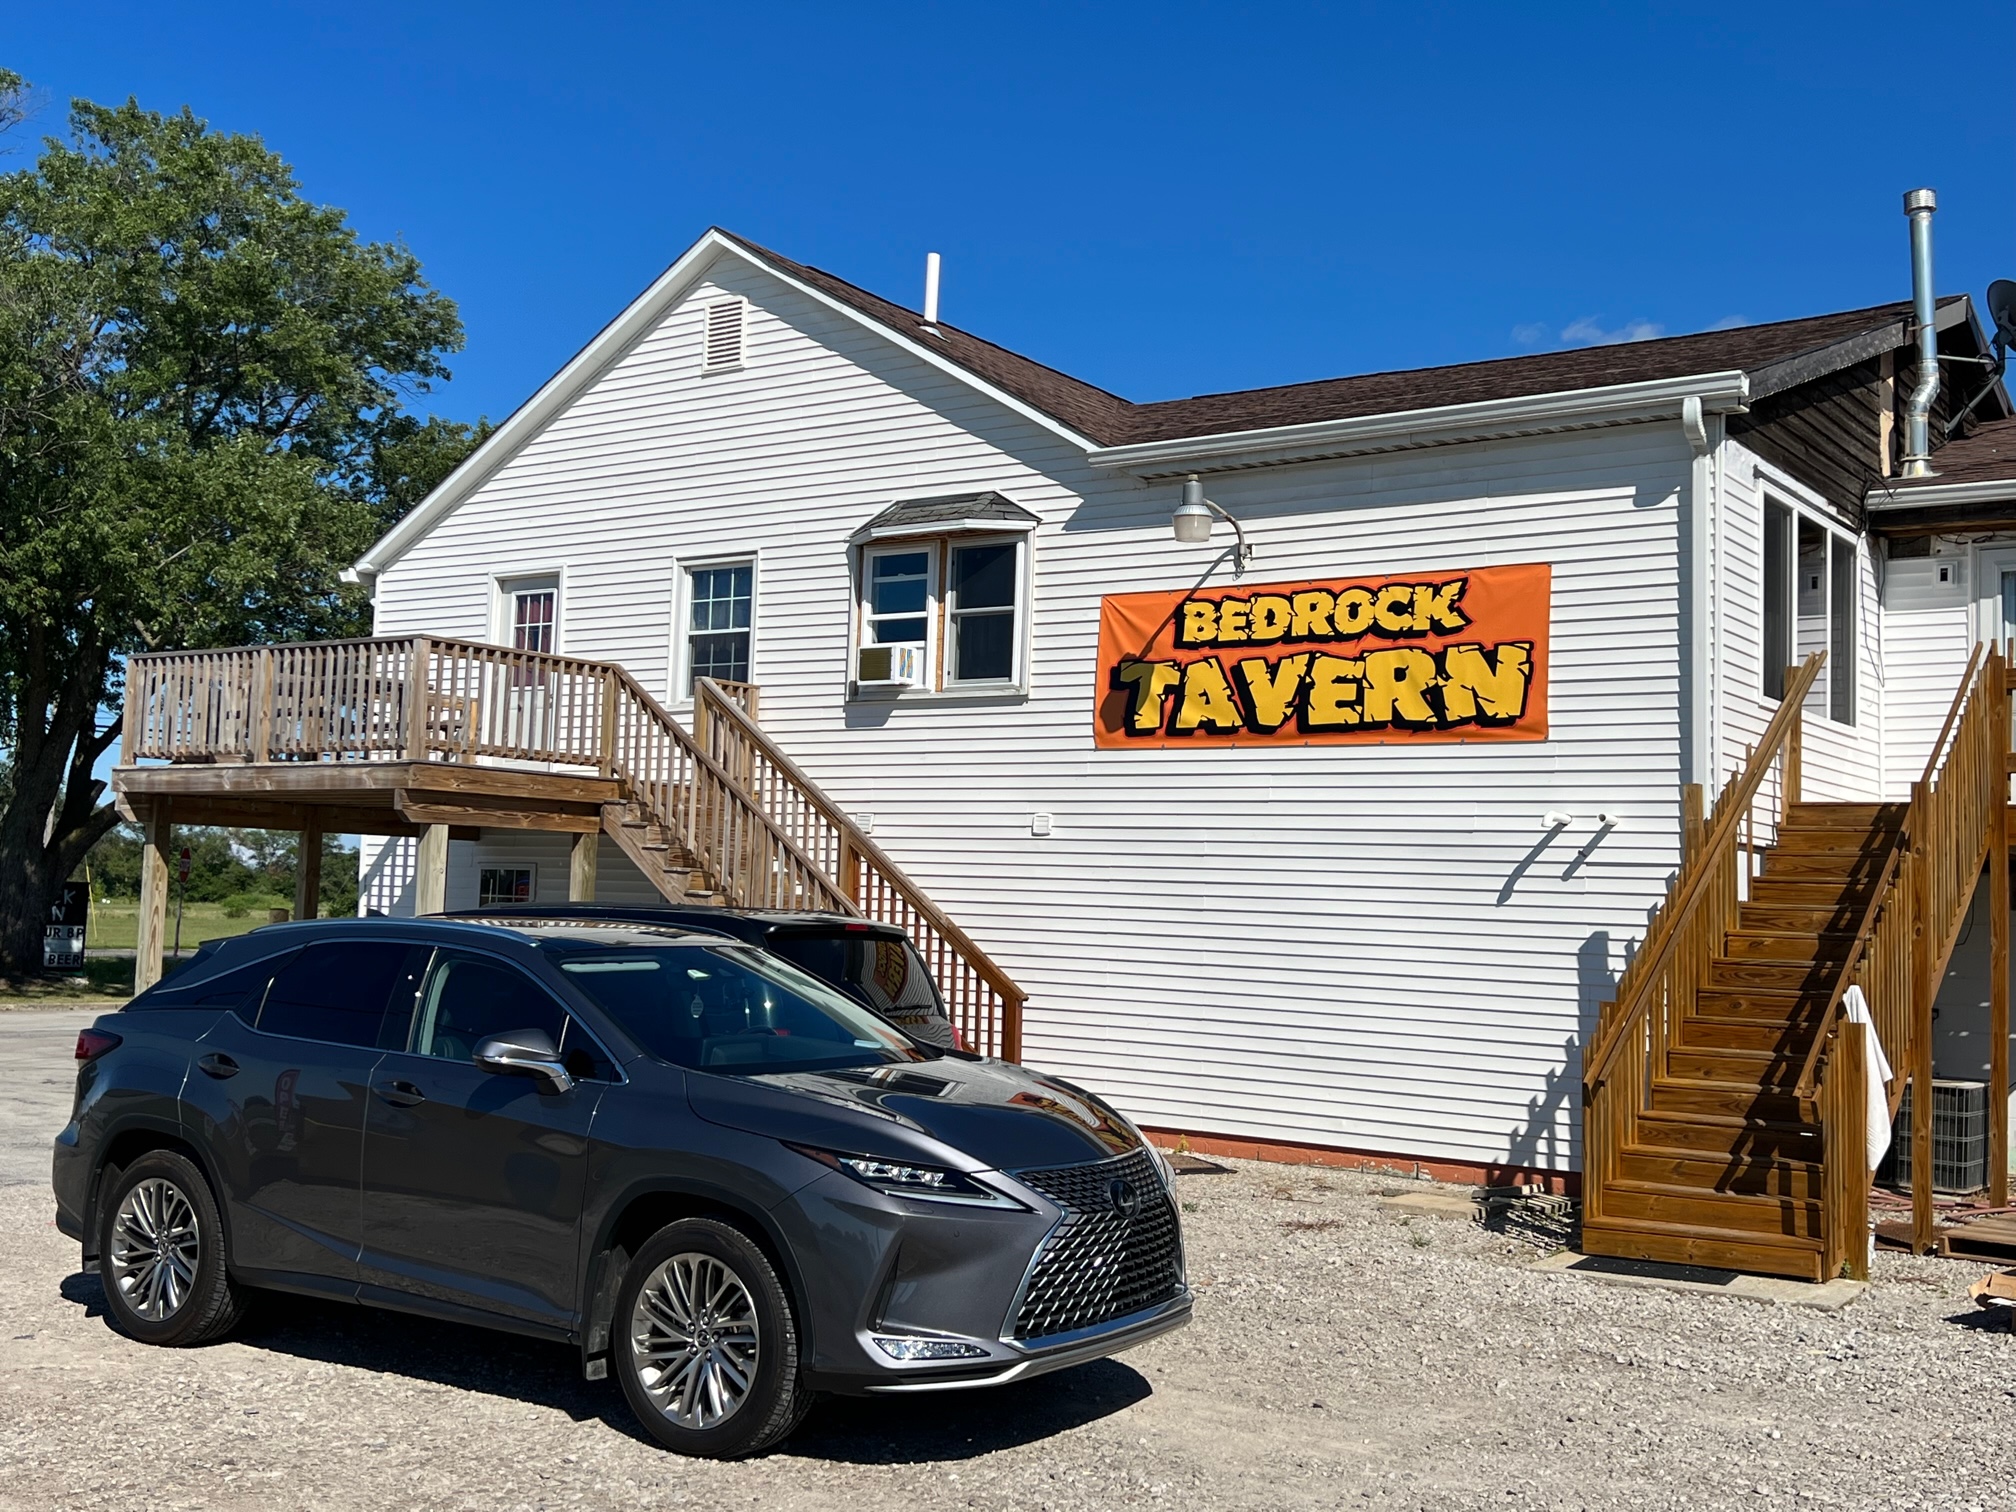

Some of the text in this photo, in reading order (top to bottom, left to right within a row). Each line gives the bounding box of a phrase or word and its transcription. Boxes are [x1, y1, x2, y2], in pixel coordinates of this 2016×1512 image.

[1176, 577, 1472, 645] BEDROCK
[1114, 641, 1534, 734] TAVERN
[45, 927, 61, 938] UR
[48, 954, 80, 965] BEER
